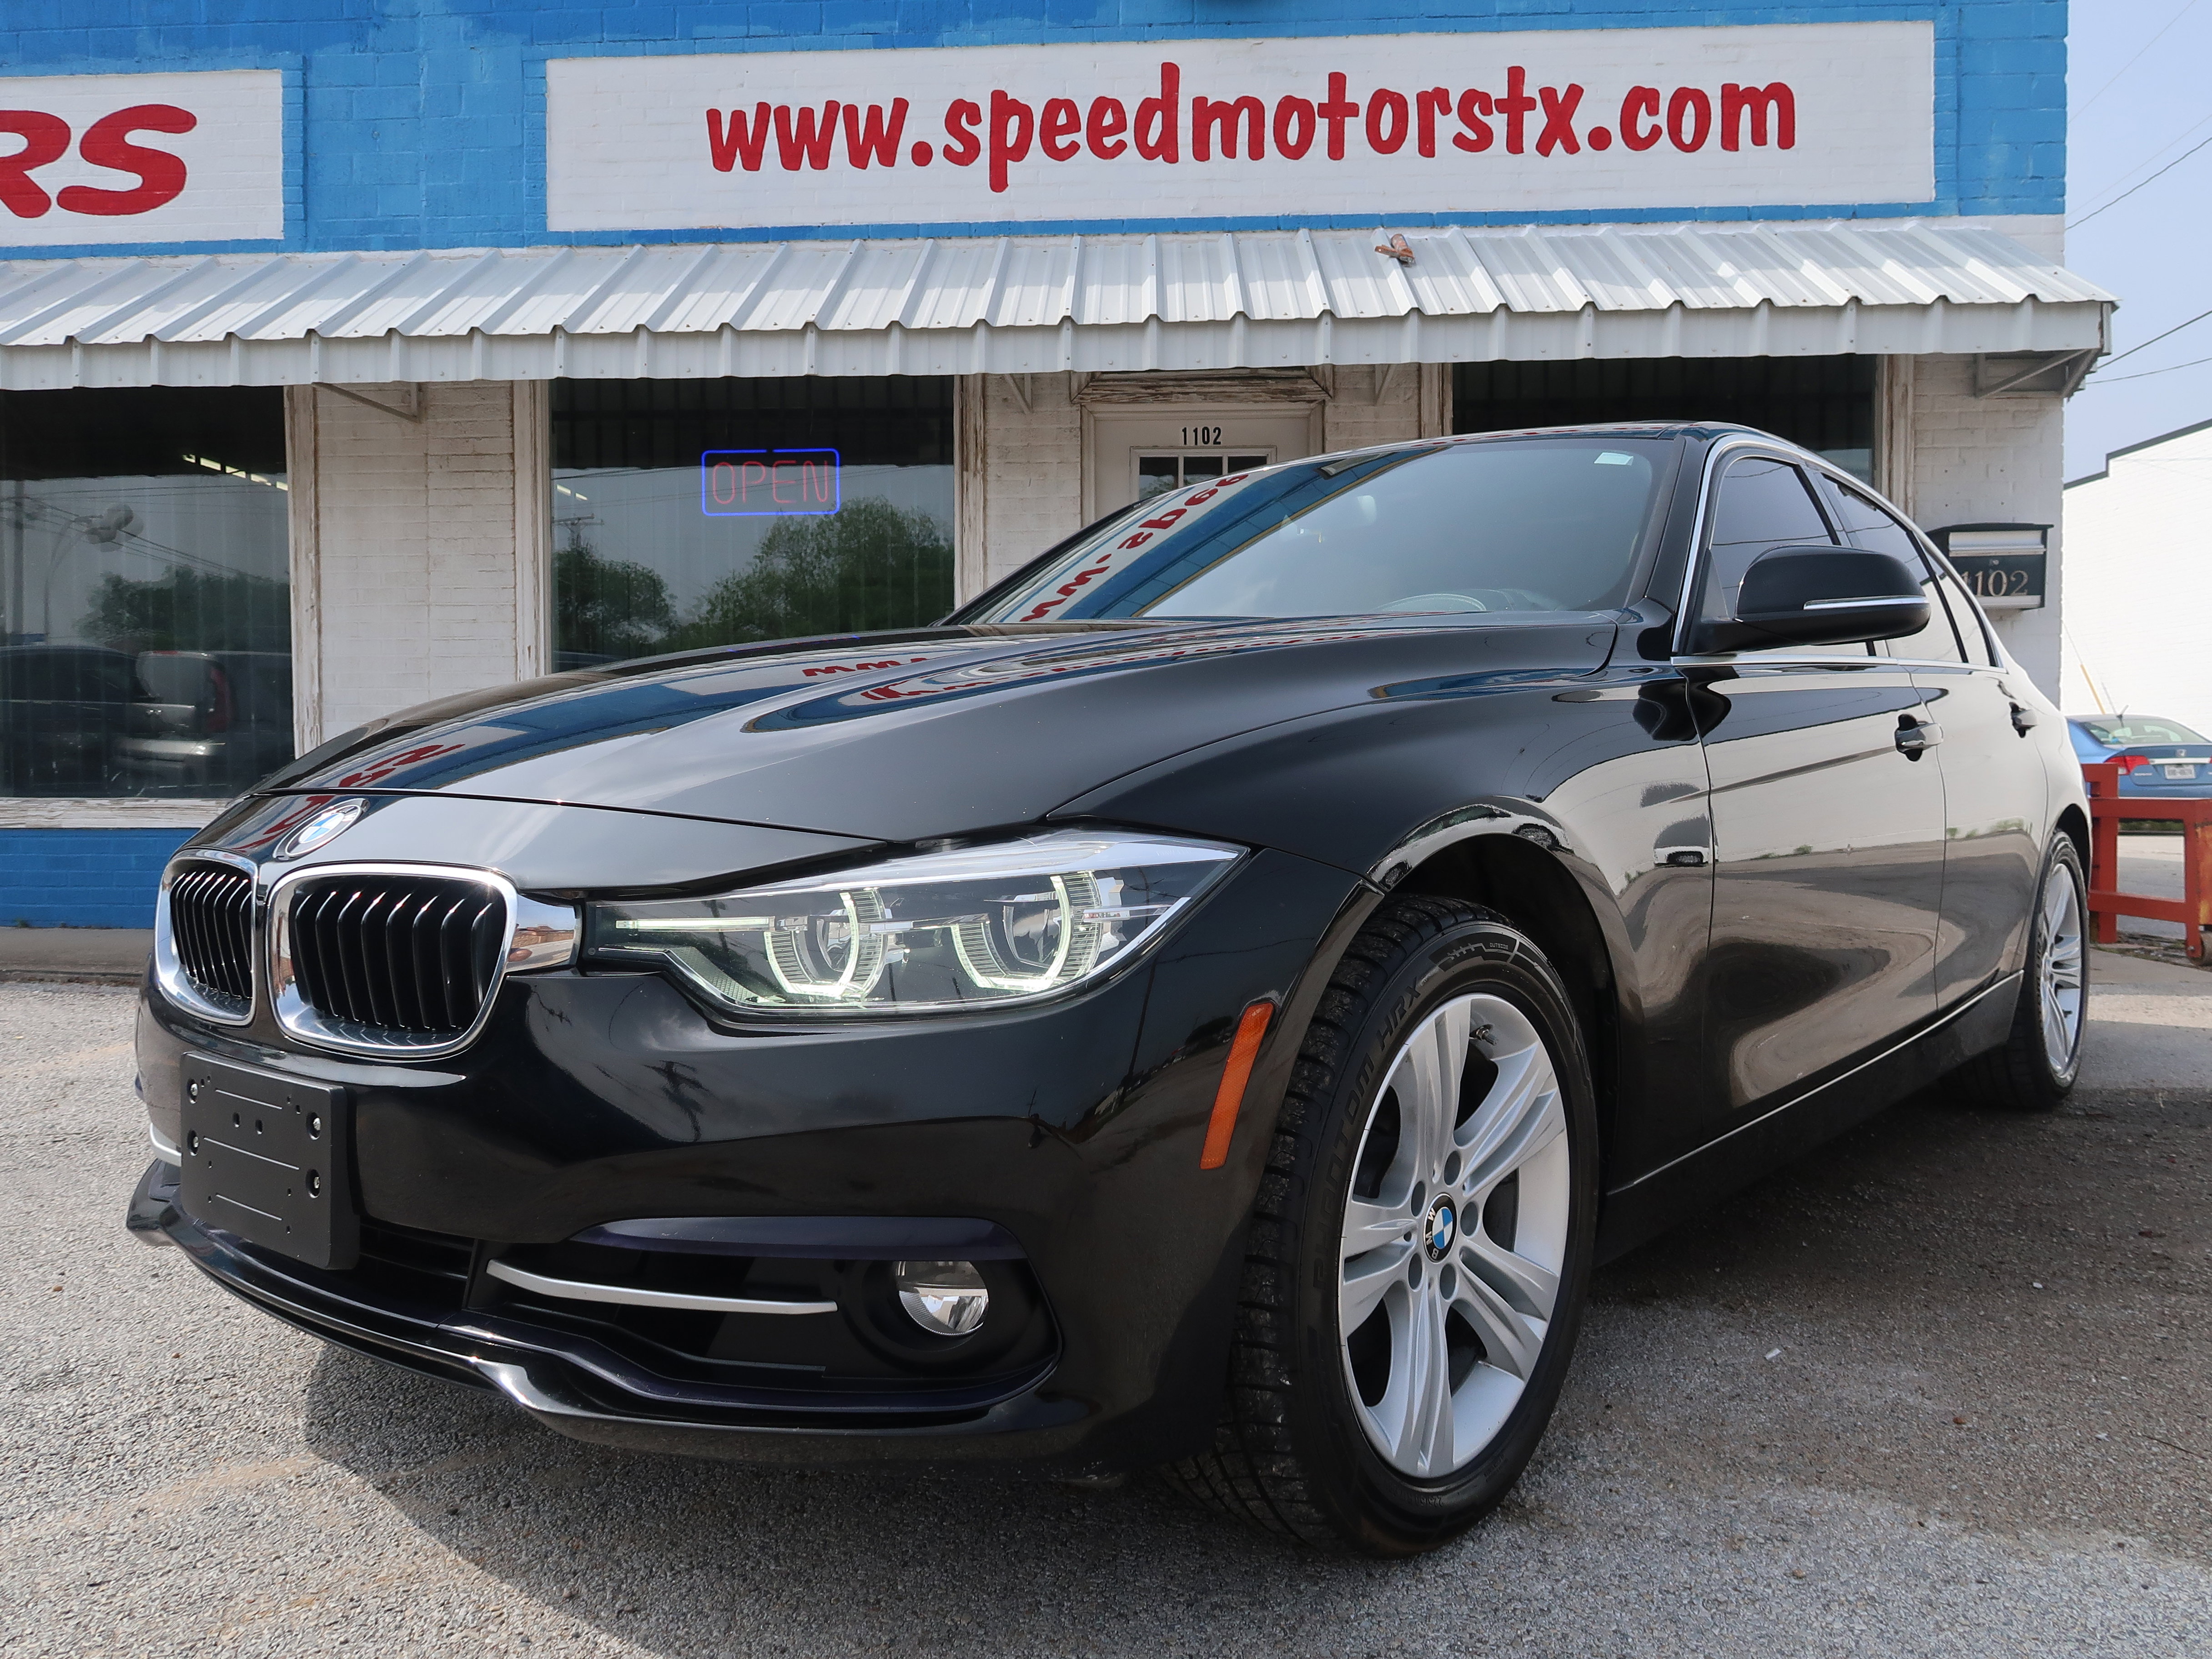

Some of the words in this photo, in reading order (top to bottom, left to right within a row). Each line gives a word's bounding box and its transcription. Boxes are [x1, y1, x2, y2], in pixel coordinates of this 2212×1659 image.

[706, 62, 1796, 193] www.speedmotorstx.com
[1181, 426, 1222, 446] 1102
[712, 460, 830, 505] OPEN
[1489, 942, 1509, 950] OUTSIDE
[1375, 976, 1423, 1052] HRX
[1426, 1207, 1439, 1259] BMW
